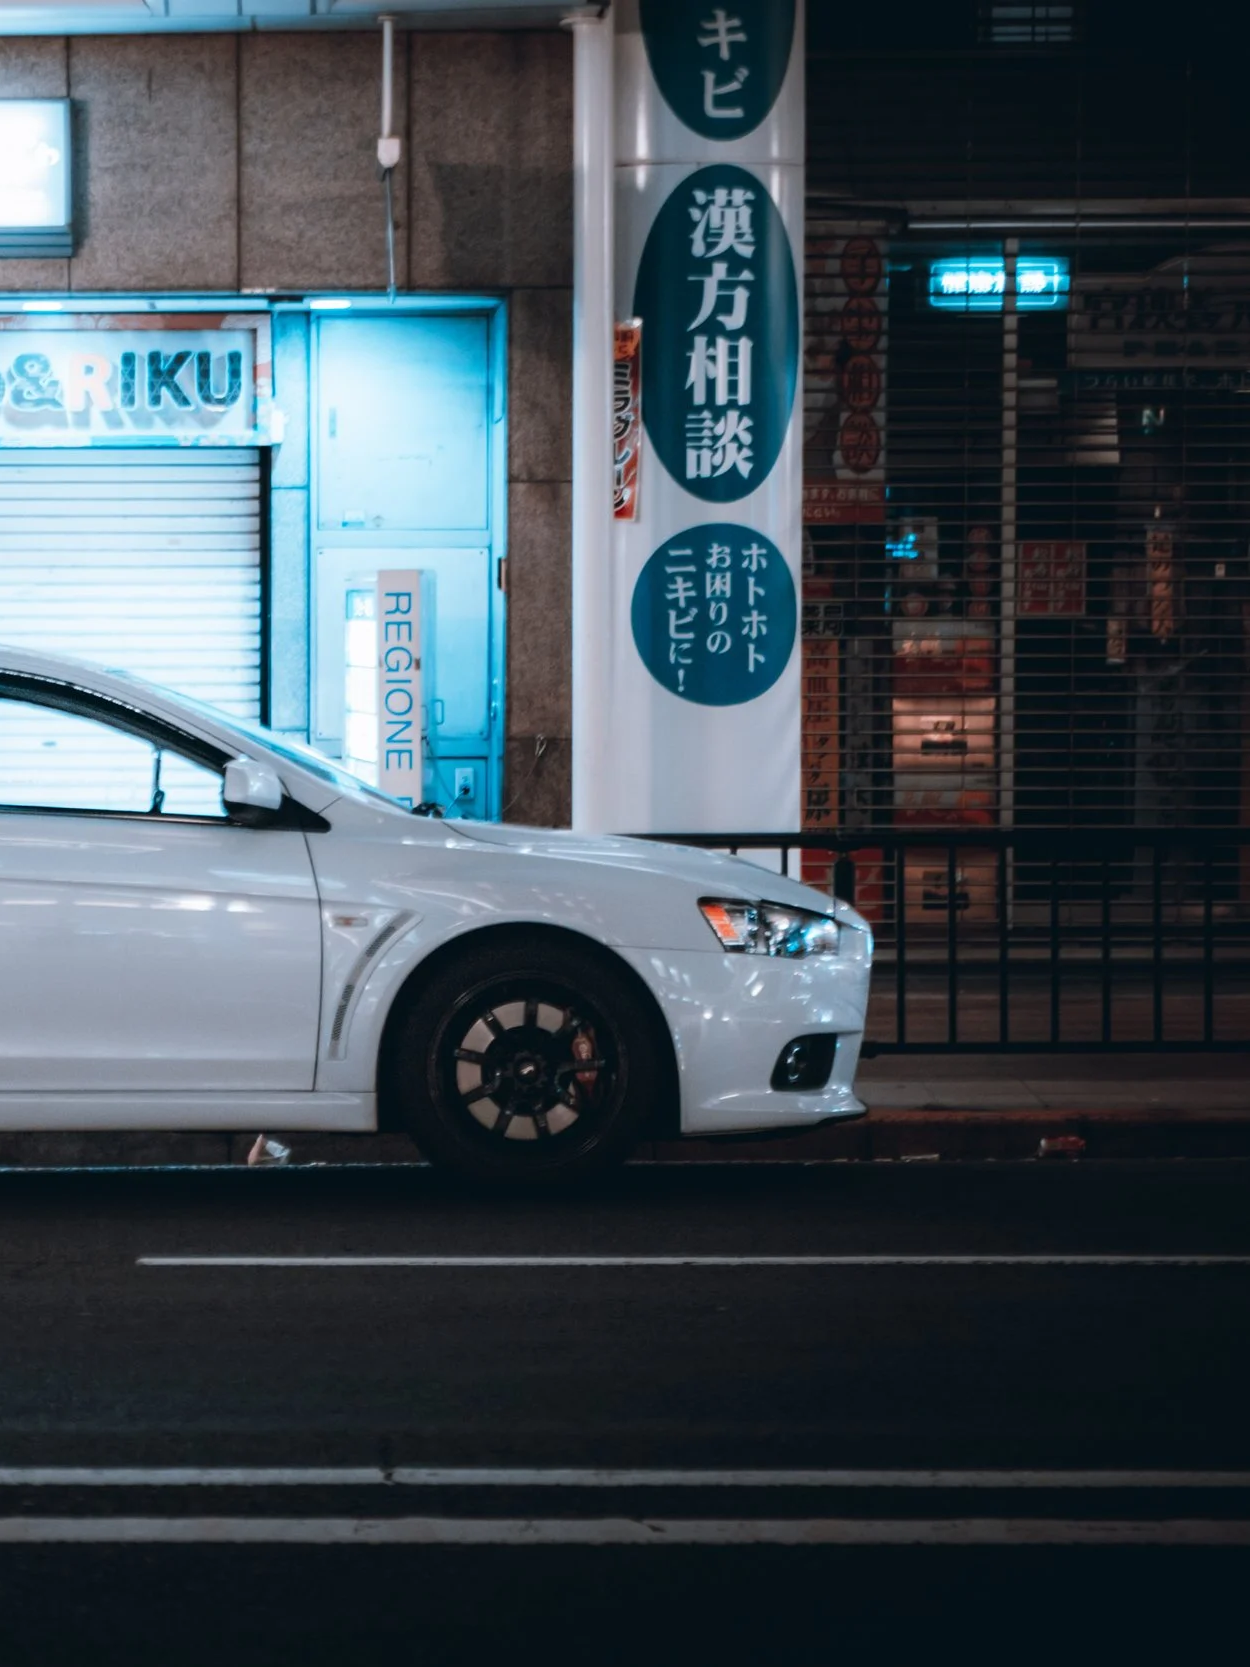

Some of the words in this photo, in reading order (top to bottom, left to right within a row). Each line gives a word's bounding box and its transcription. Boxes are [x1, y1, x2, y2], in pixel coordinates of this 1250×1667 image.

[696, 9, 748, 119] キビ
[684, 187, 756, 480] 漢方相談
[705, 542, 732, 654] お困りの
[740, 543, 768, 673] ホトホト
[384, 591, 413, 771] REGIONE
